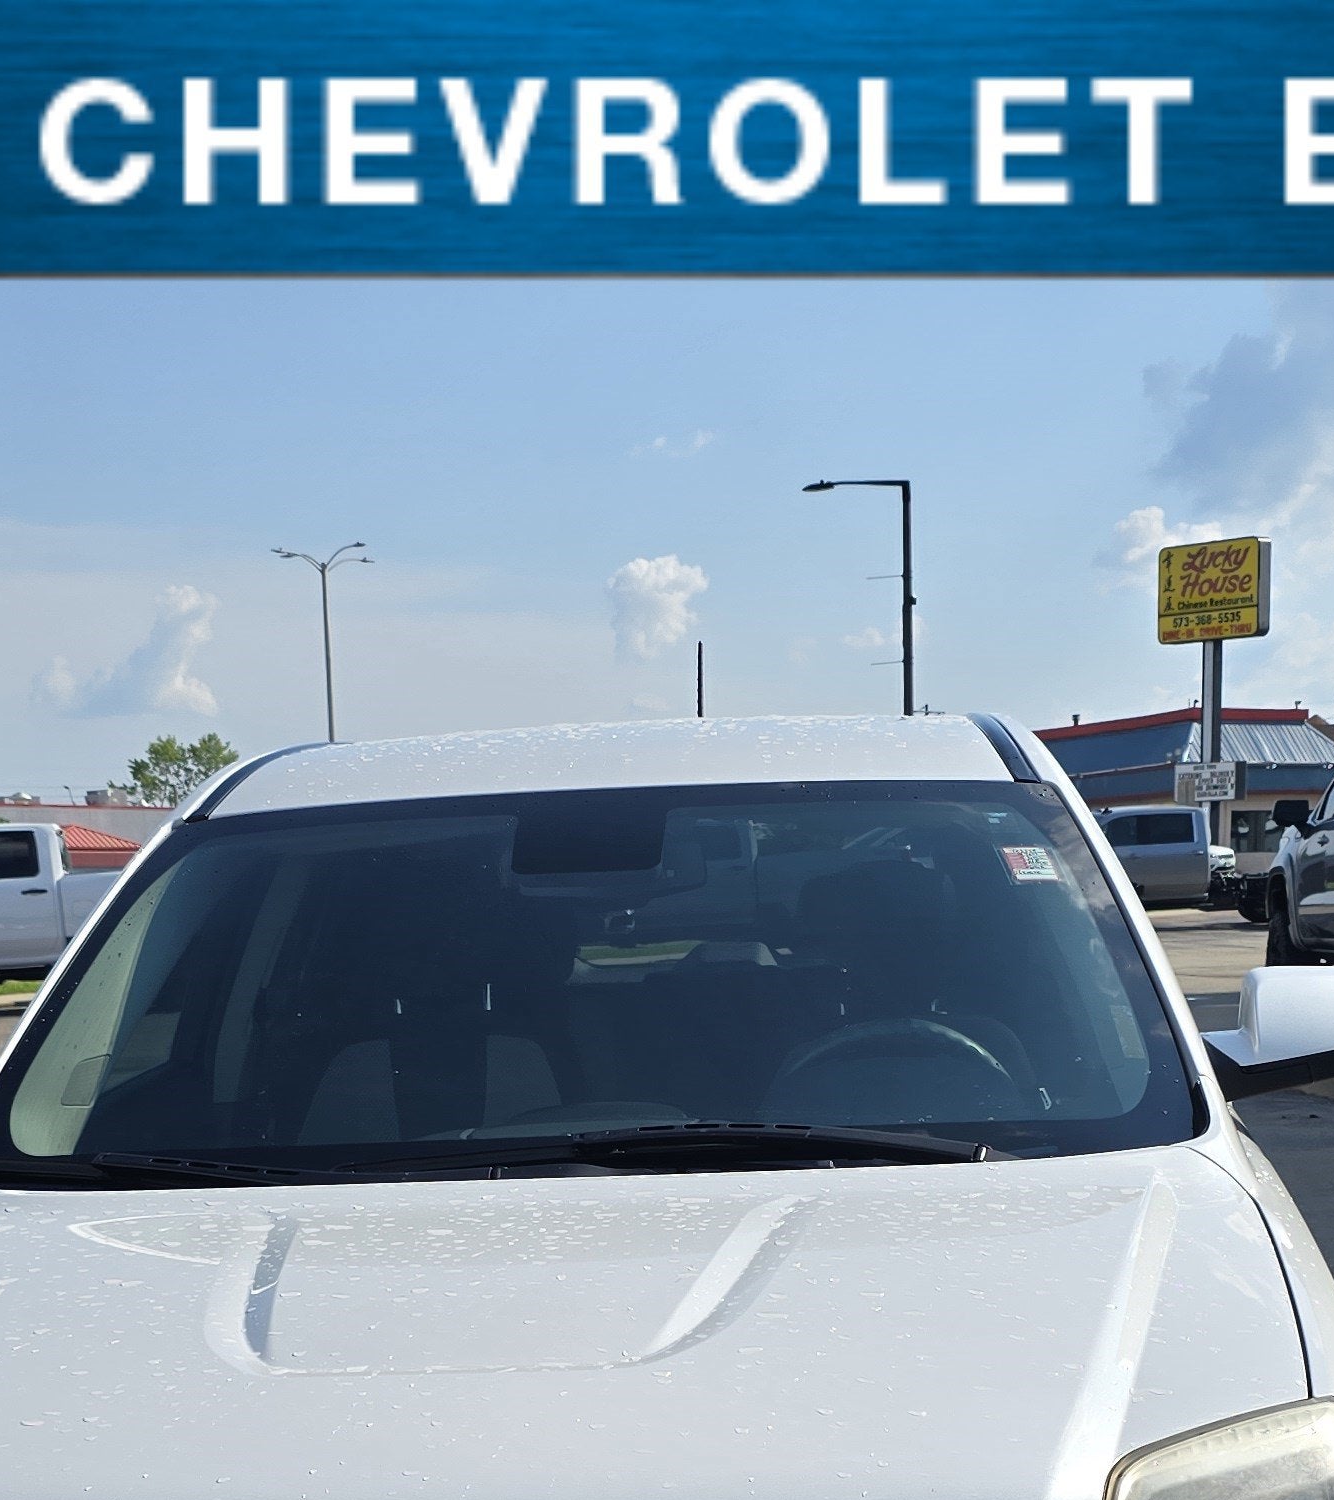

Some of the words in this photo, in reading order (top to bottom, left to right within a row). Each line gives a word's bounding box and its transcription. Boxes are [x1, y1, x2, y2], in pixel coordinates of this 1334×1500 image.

[1182, 544, 1251, 575] Lucky
[1179, 573, 1253, 598] House
[1177, 600, 1208, 610] Chinese
[1209, 593, 1254, 607] Restaurant
